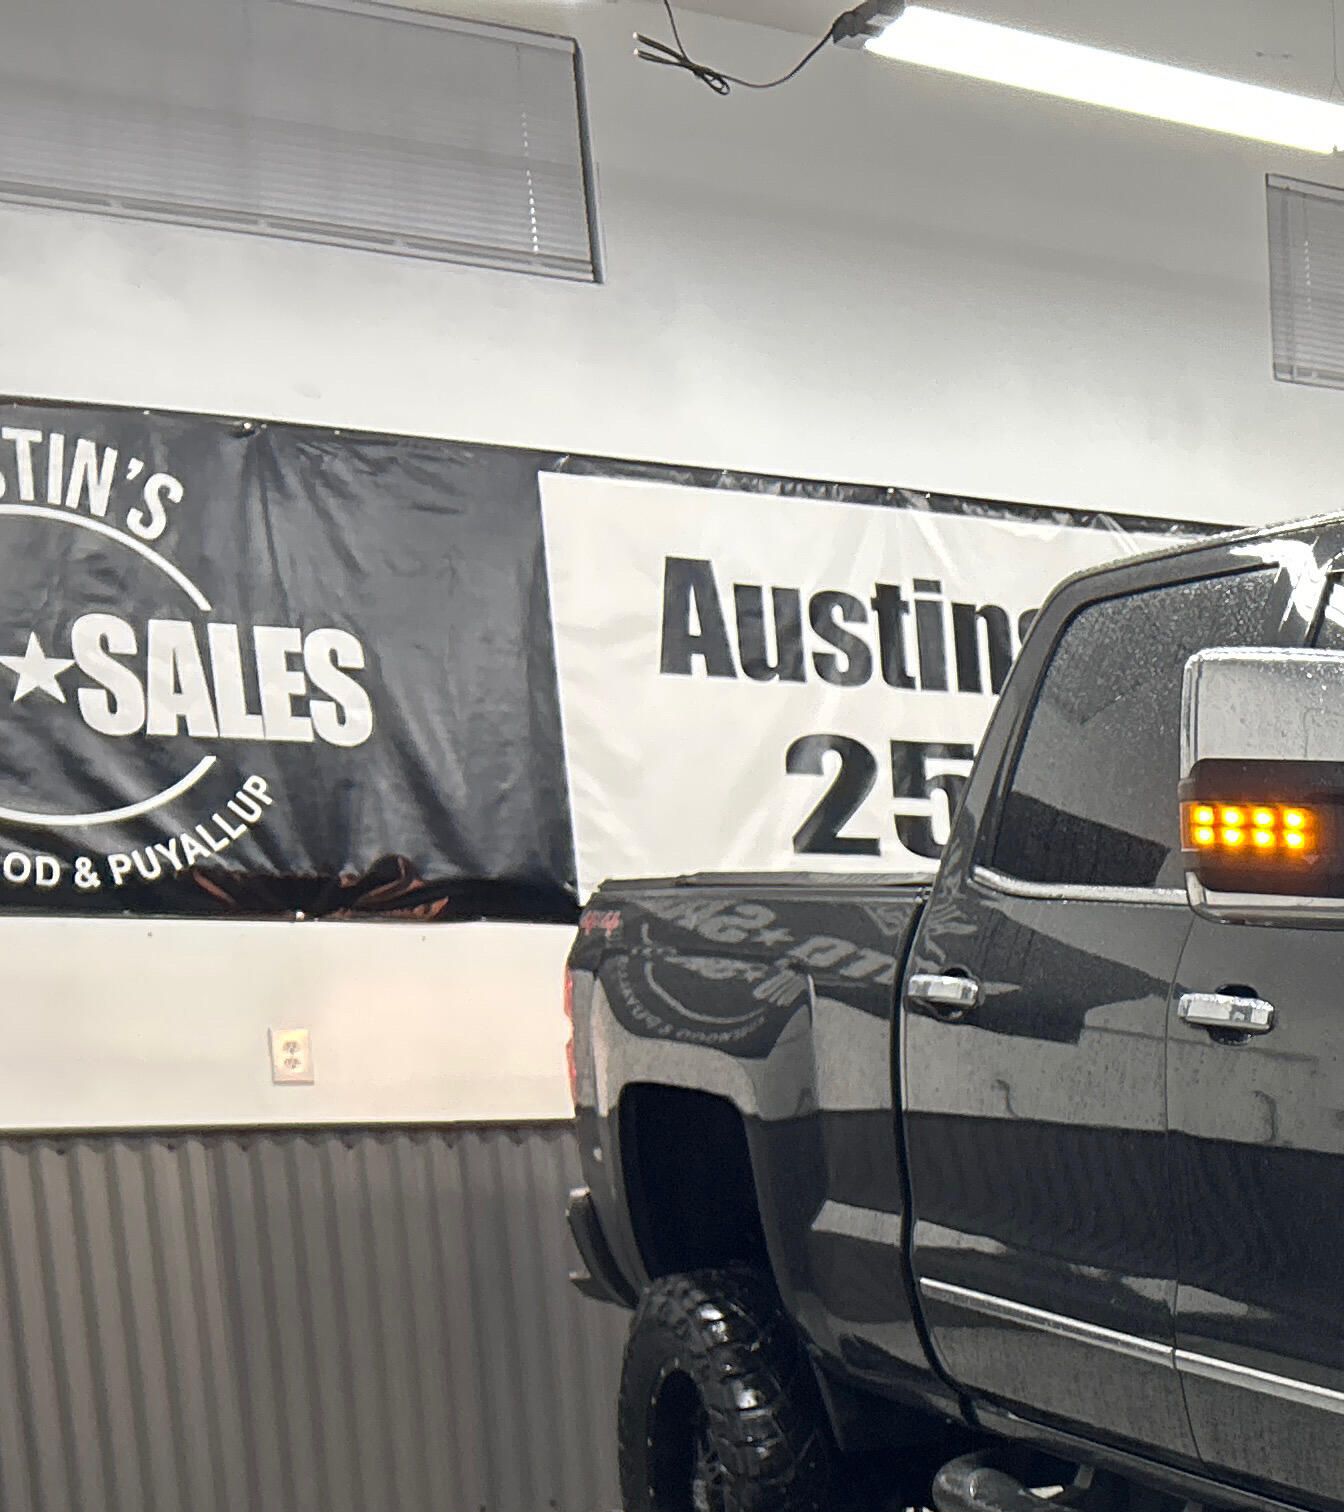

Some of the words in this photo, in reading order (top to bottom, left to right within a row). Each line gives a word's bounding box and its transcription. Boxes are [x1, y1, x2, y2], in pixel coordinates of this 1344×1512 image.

[0, 427, 185, 541] TIN'S
[70, 612, 375, 748] SALES
[73, 856, 101, 888] &
[111, 773, 274, 886] PUYALLUP
